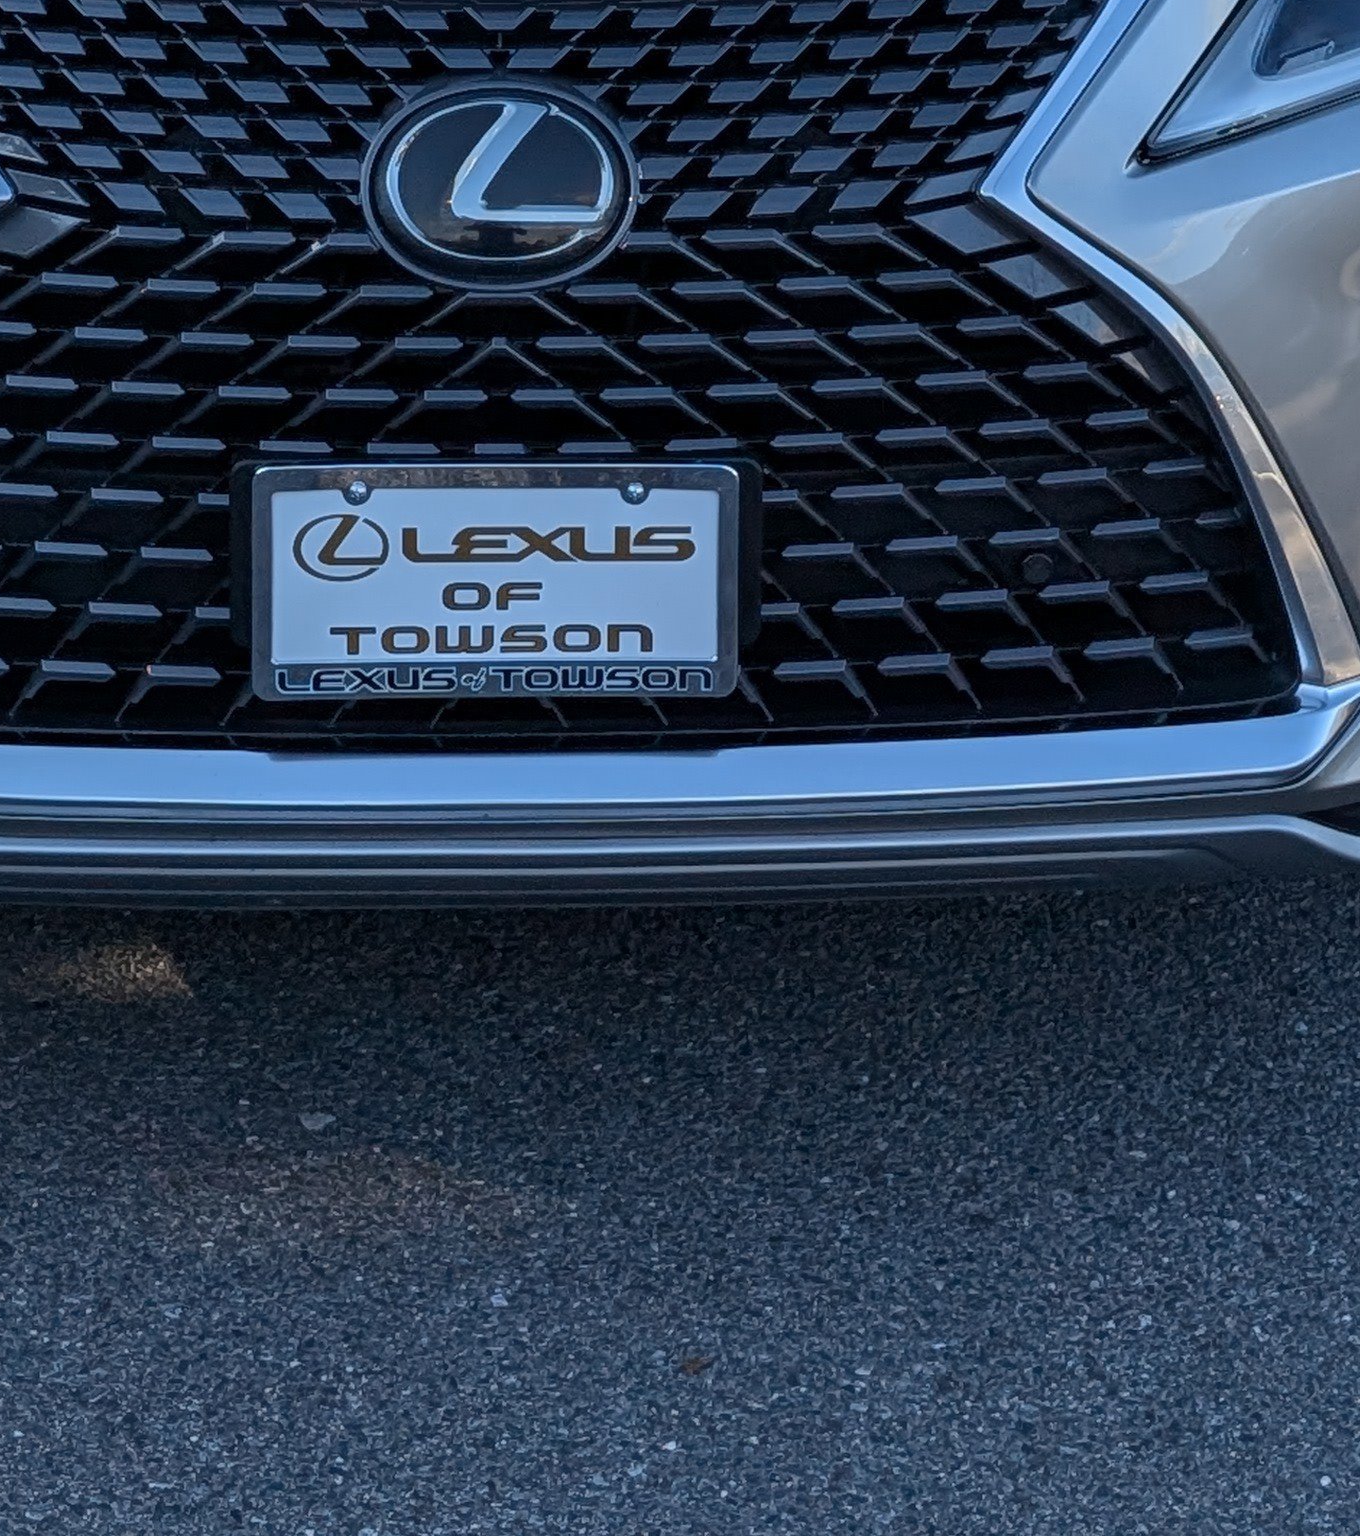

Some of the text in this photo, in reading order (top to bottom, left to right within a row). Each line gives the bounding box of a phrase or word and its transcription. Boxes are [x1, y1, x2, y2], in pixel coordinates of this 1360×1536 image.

[401, 525, 696, 563] LEXUS
[441, 582, 543, 611] OF
[329, 624, 654, 656] TOWSON
[275, 665, 713, 694] LEXUS of TOWSON
